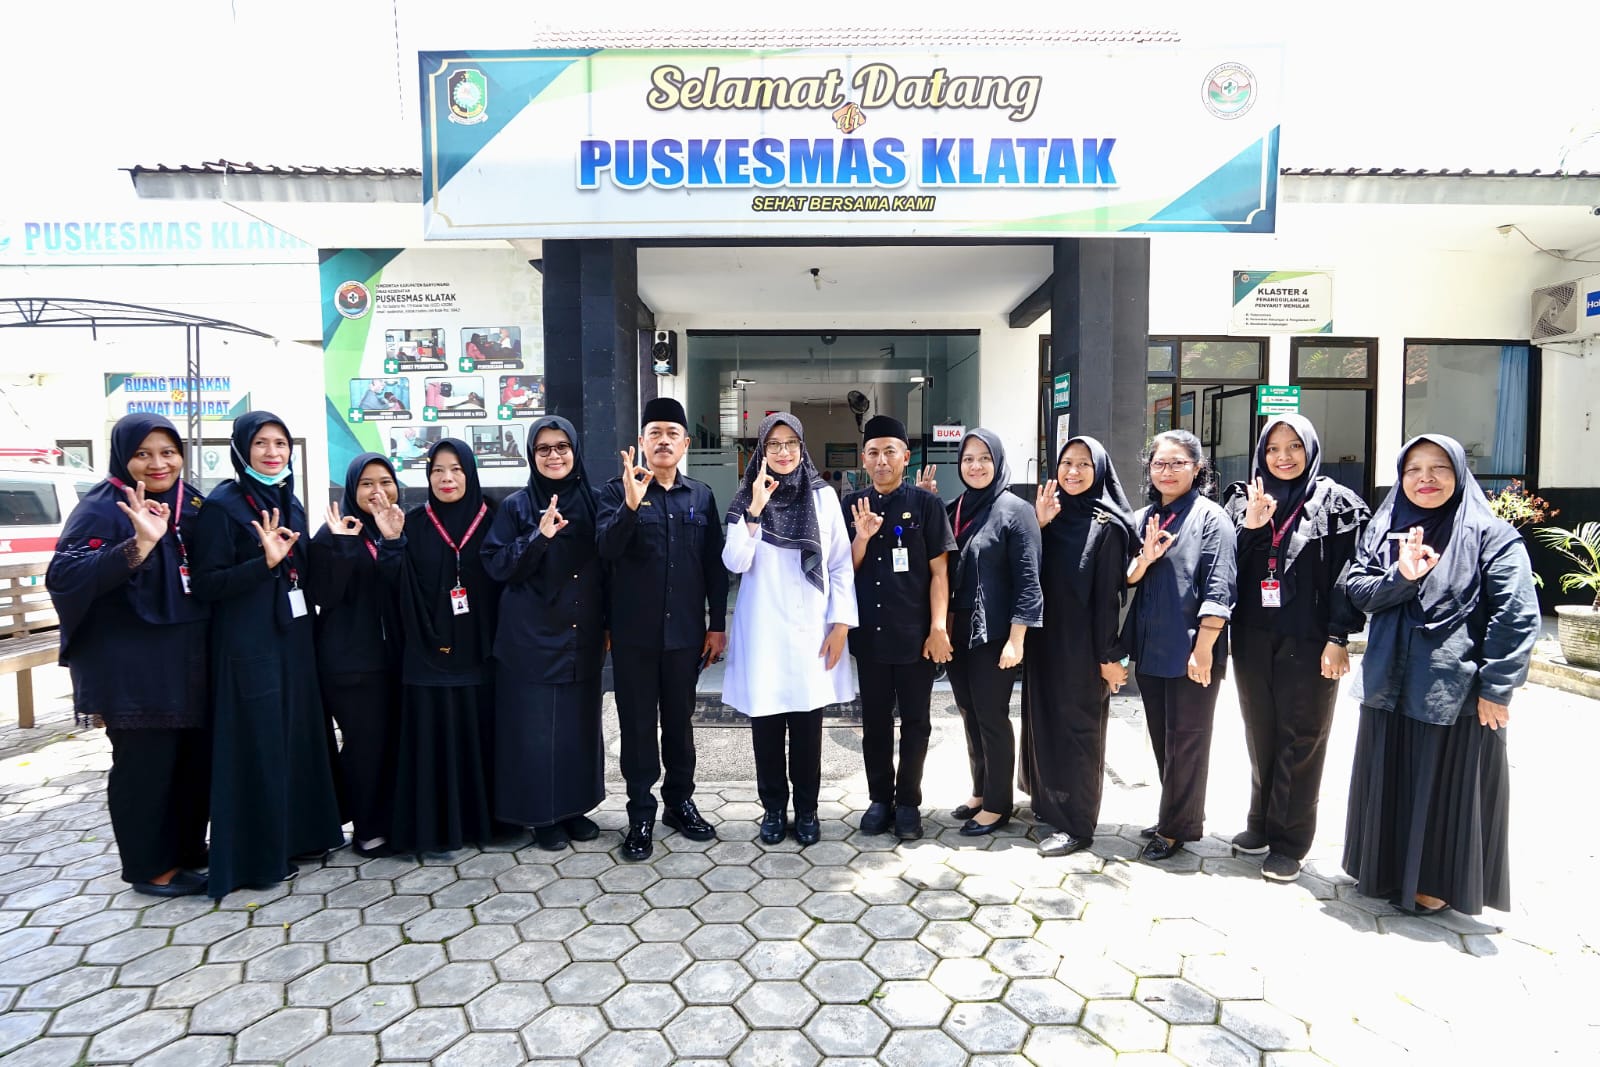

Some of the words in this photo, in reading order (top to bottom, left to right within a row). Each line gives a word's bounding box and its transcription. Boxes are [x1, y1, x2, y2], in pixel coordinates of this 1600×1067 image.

[647, 64, 844, 111] Selamat
[852, 63, 1042, 122] Datang
[837, 104, 860, 130] di
[577, 137, 907, 188] PUSKESMAS
[920, 137, 1118, 188] KLATAK
[752, 196, 808, 211] SEHAT
[808, 196, 890, 211] BERSAMA
[891, 196, 936, 211] KAMI
[24, 222, 201, 250] PUSKESMAS
[211, 222, 309, 249] KLATA
[376, 294, 423, 302] PUSKESMAS
[425, 293, 456, 301] KLATAK
[1257, 288, 1300, 296] KLASTER
[125, 378, 166, 392] RUANG
[169, 377, 231, 392] TINDAKAN
[127, 401, 170, 416] GAWAT
